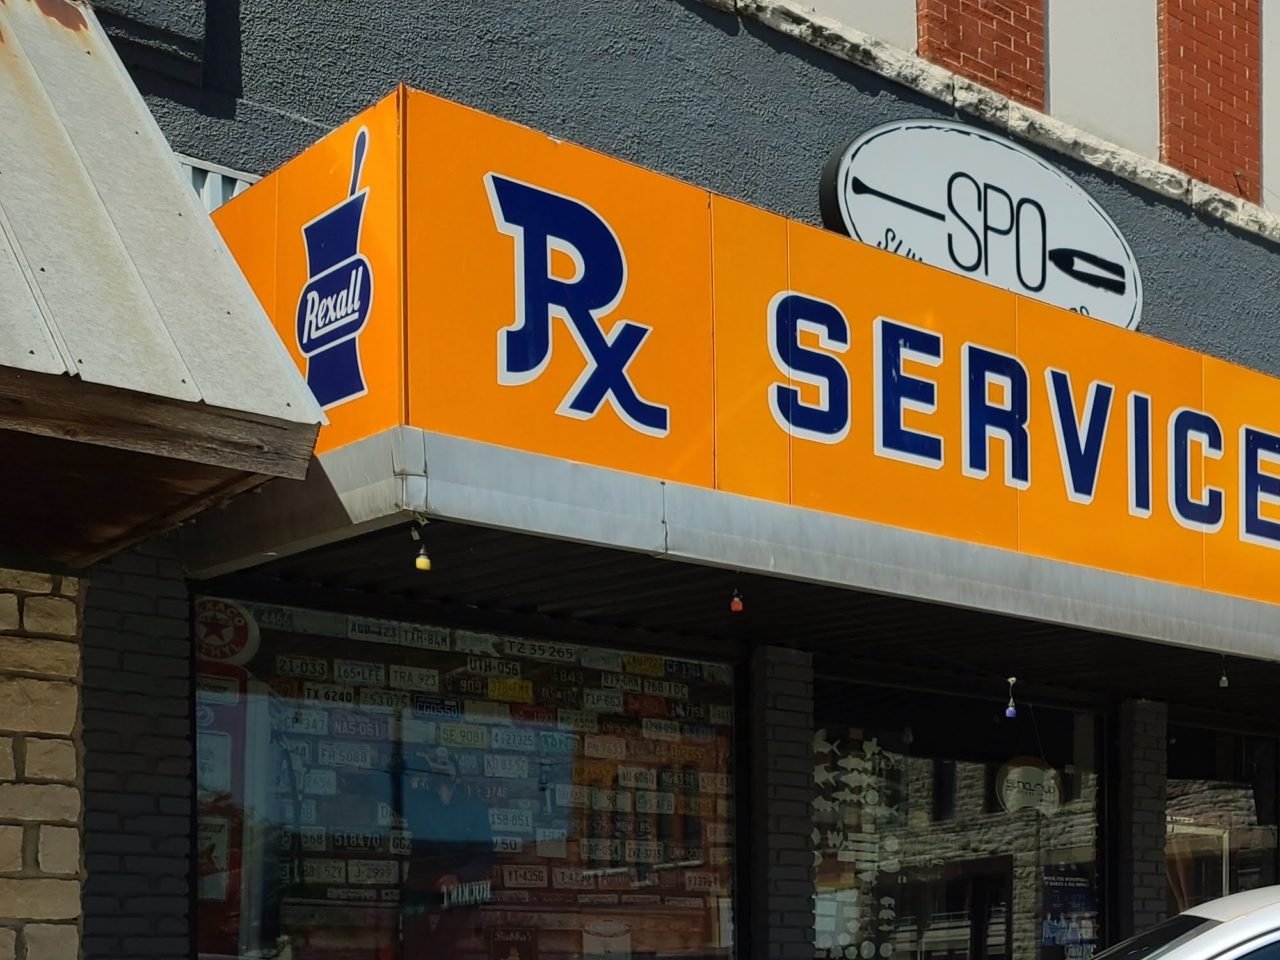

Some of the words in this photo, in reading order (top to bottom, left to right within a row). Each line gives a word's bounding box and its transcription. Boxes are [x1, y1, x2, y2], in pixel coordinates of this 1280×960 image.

[947, 171, 1046, 292] SPO
[302, 266, 364, 344] Rexall
[483, 171, 669, 439] Rx
[530, 644, 545, 656] 35
[549, 646, 573, 659] 265
[306, 688, 320, 700] TX
